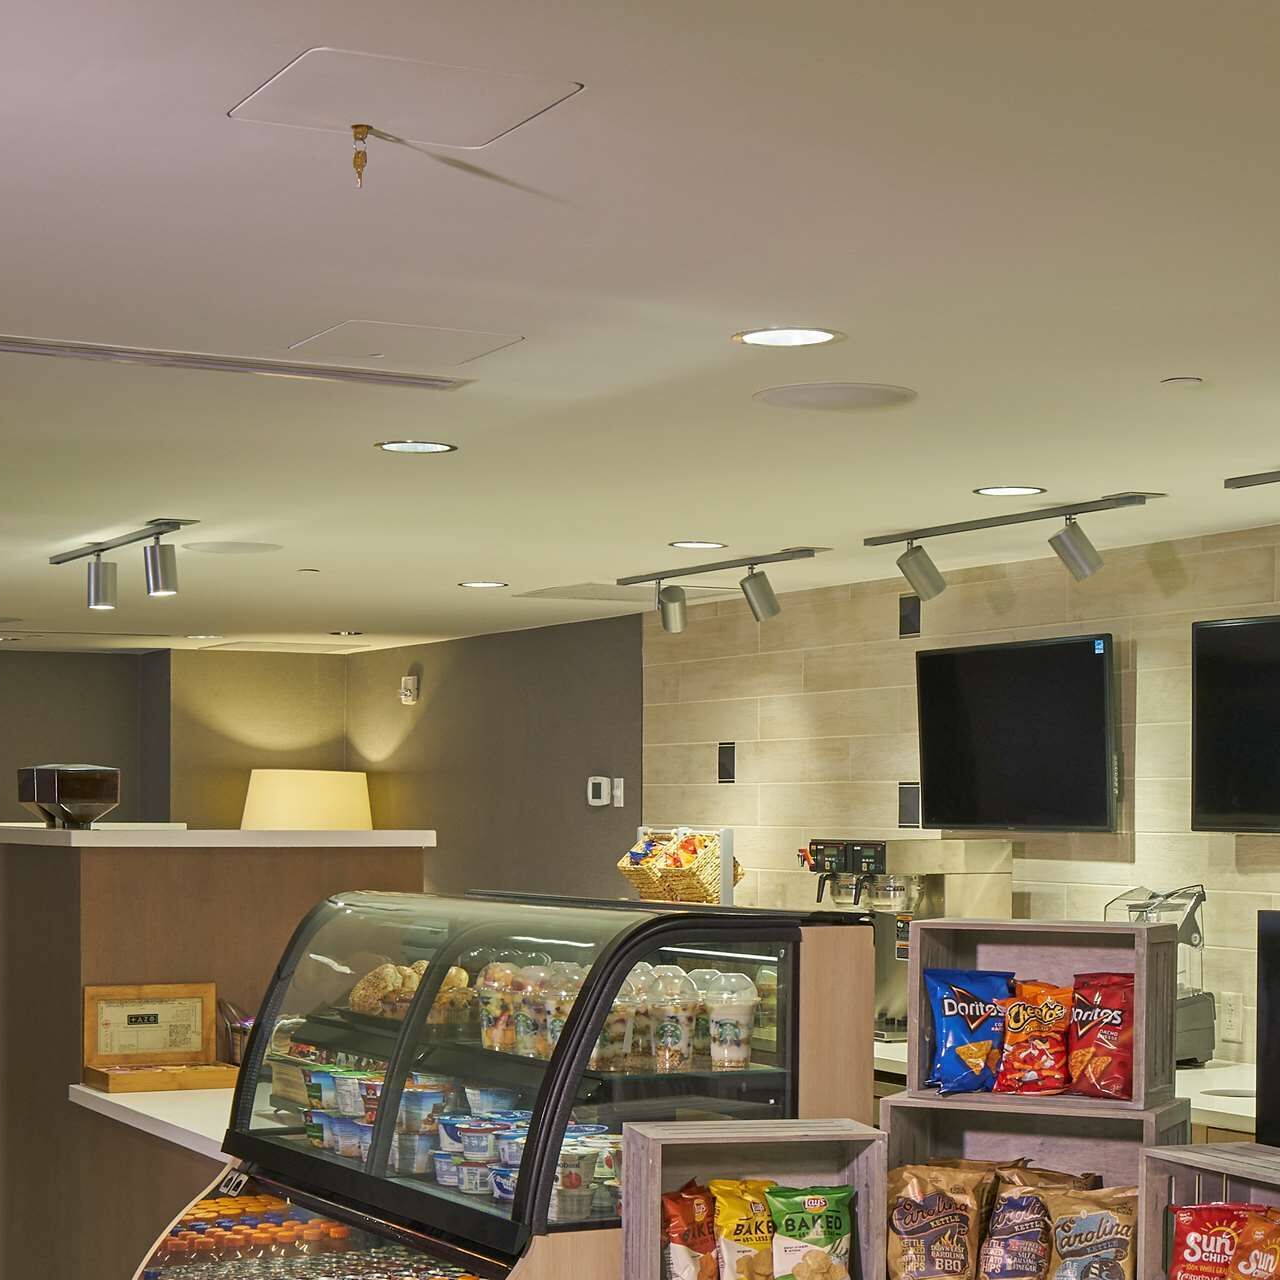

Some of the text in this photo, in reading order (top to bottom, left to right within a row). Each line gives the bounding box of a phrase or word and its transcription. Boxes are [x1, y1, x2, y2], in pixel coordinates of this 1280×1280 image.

[944, 998, 1006, 1018] Doritos
[1008, 1001, 1066, 1031] Cheetos
[785, 1214, 842, 1232] BAKED
[930, 1216, 961, 1228] KETTLE
[1183, 1231, 1235, 1263] Sun
[935, 1258, 962, 1272] BBQ
[1237, 1250, 1276, 1276] Sun
